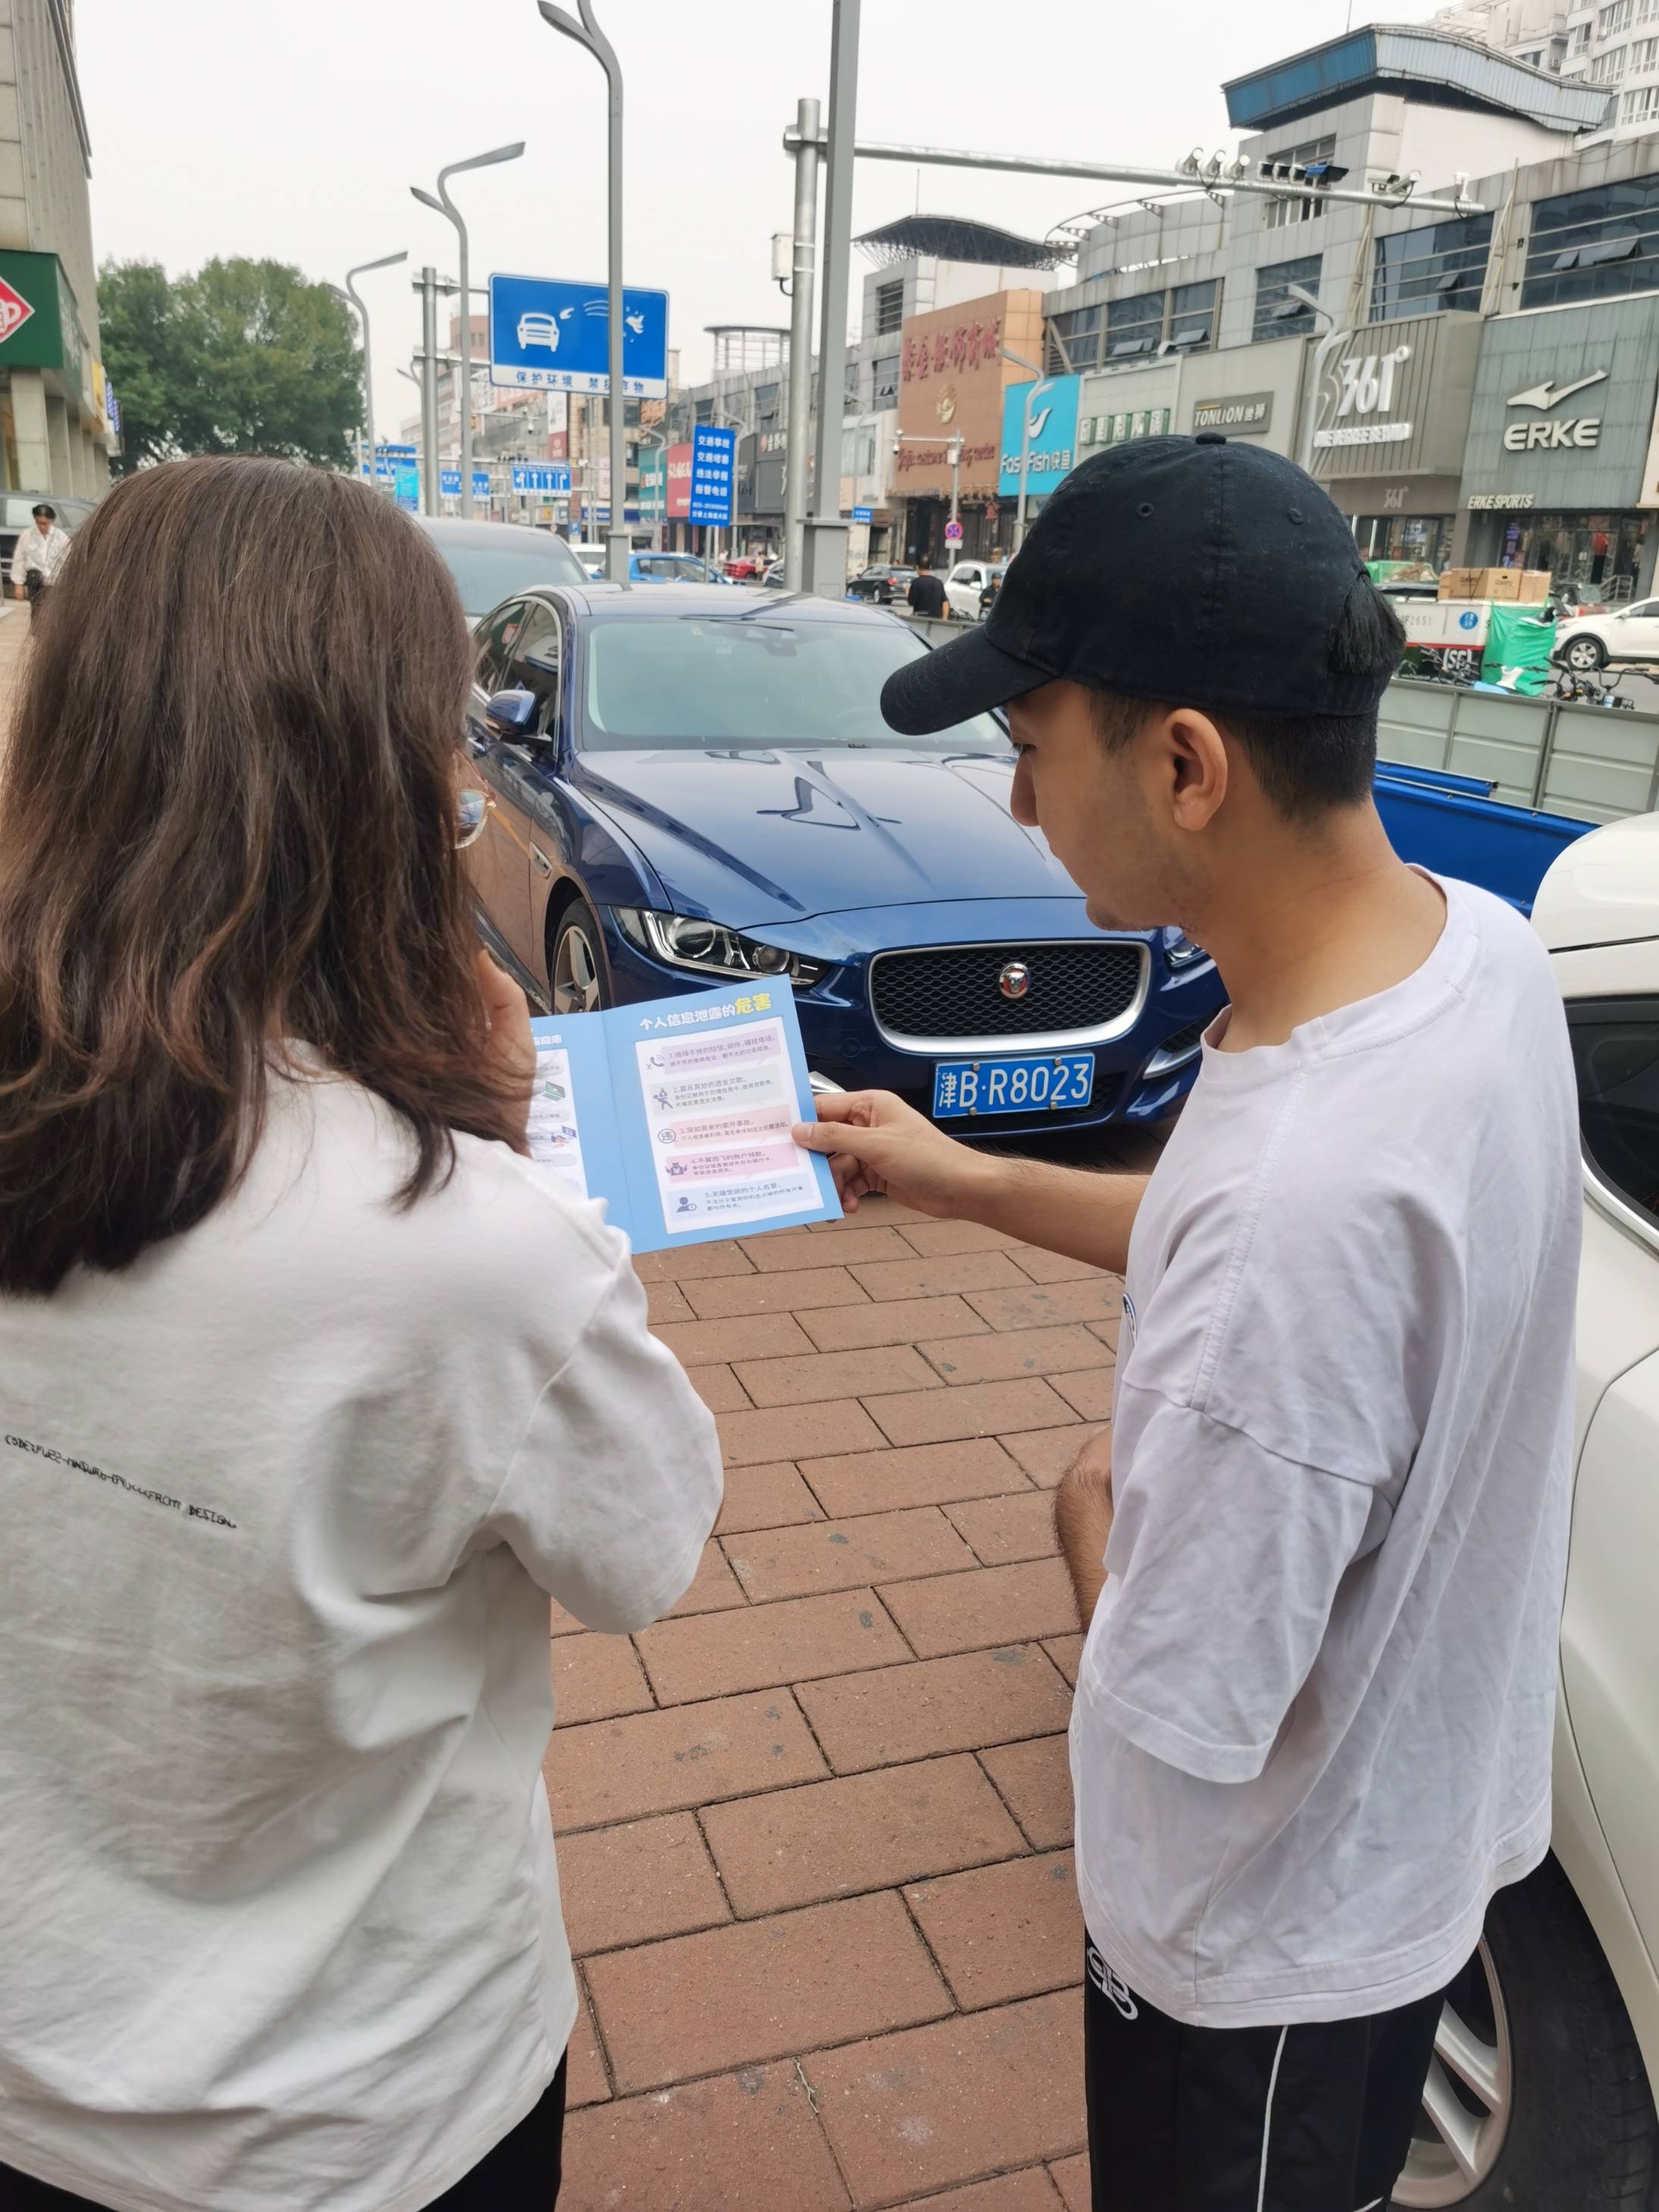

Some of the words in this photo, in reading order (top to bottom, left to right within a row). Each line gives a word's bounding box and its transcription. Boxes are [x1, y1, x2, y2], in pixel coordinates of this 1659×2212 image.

[516, 371, 573, 388] 保护环境
[1194, 405, 1244, 427] TONLION
[1504, 418, 1601, 451] ERKE
[1467, 495, 1494, 509] ERKE
[1494, 493, 1534, 509] SPORTS
[639, 993, 772, 1031] 个人信息泄露的危害
[939, 1064, 1090, 1108] 津B·R8023
